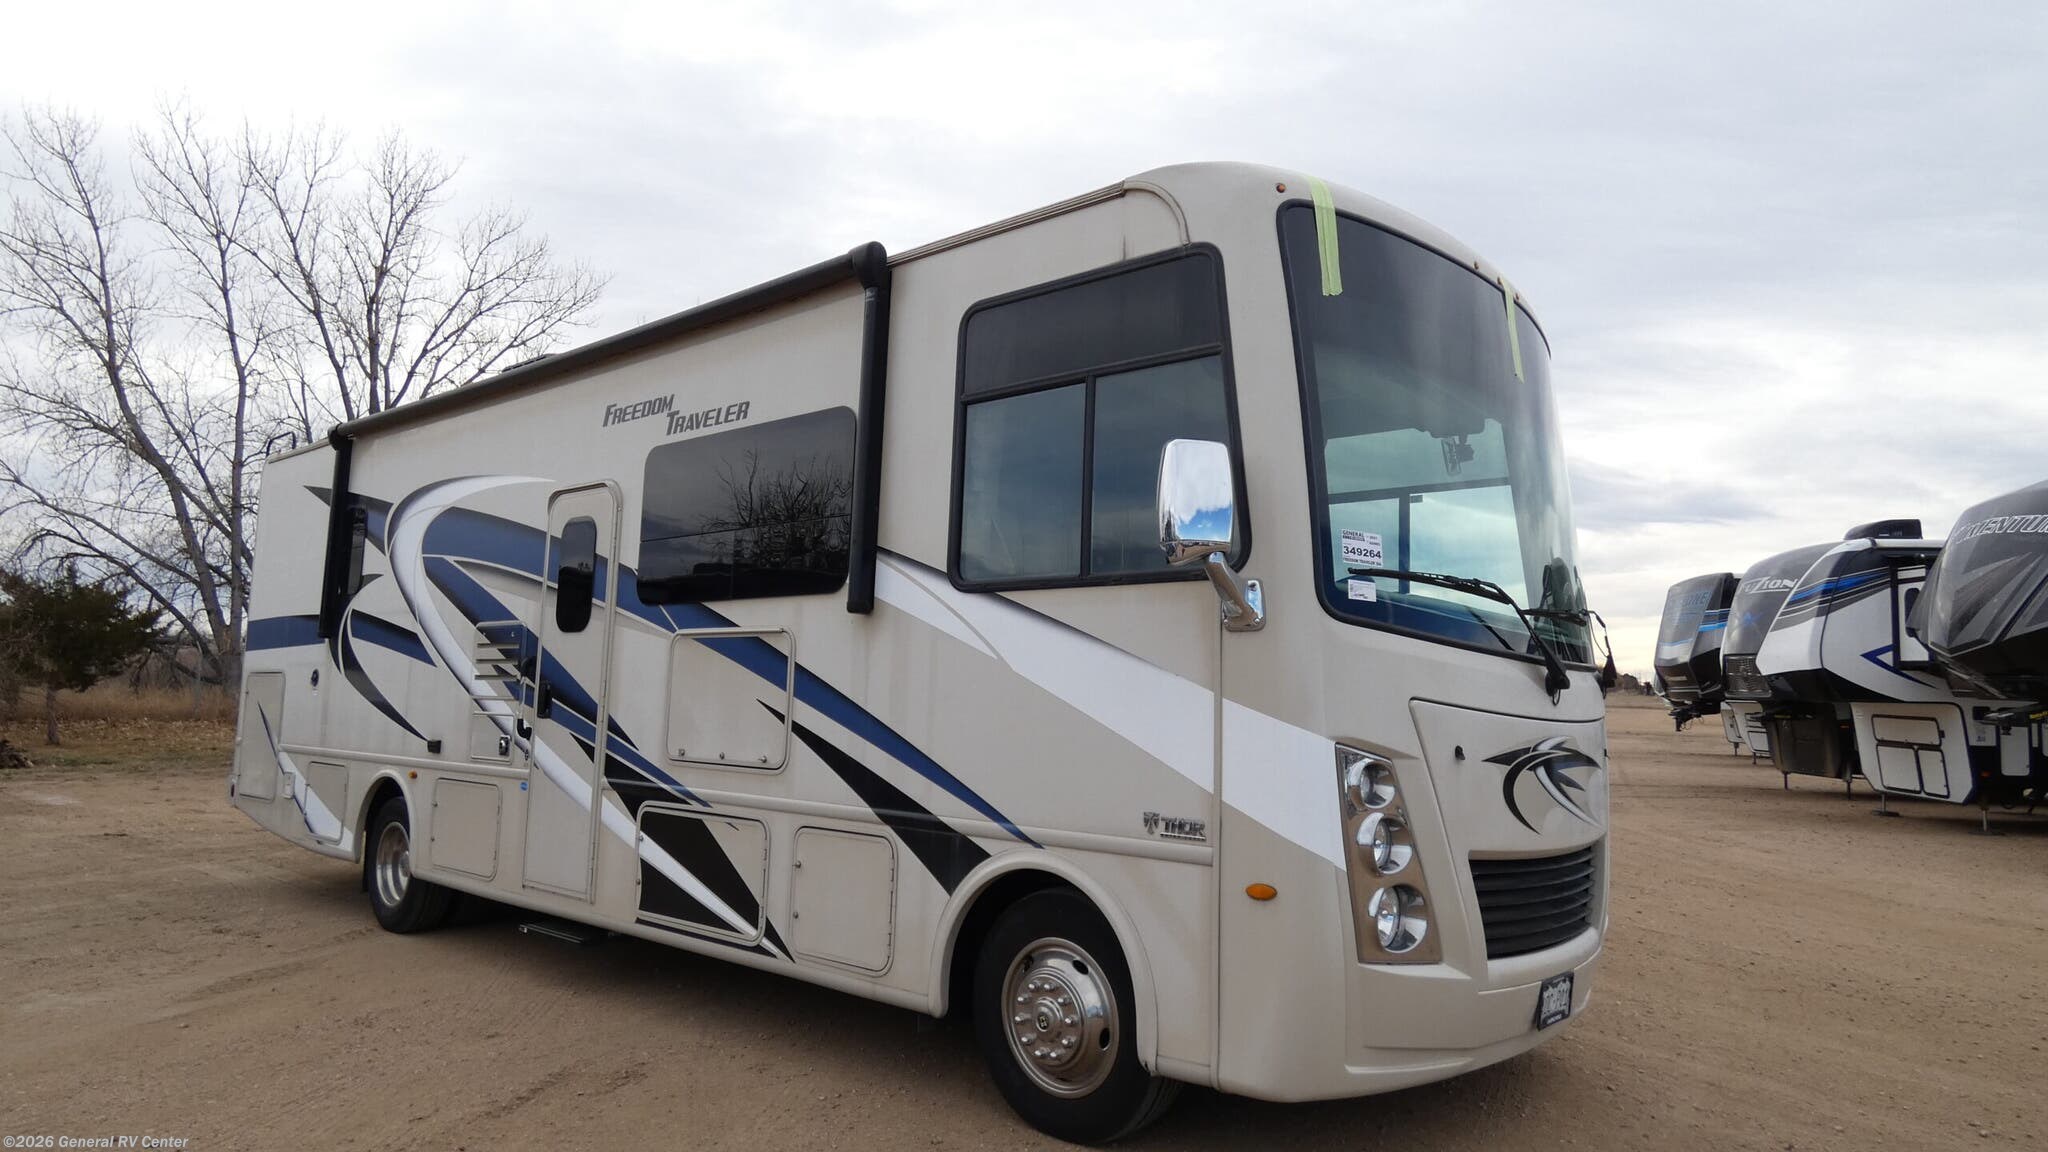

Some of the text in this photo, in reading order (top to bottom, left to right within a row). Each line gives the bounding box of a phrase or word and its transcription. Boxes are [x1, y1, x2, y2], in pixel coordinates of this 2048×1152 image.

[602, 394, 675, 427] FREEDOM
[666, 401, 750, 436] TRAVELER
[1343, 545, 1382, 560] 349264
[1160, 816, 1206, 837] THOR
